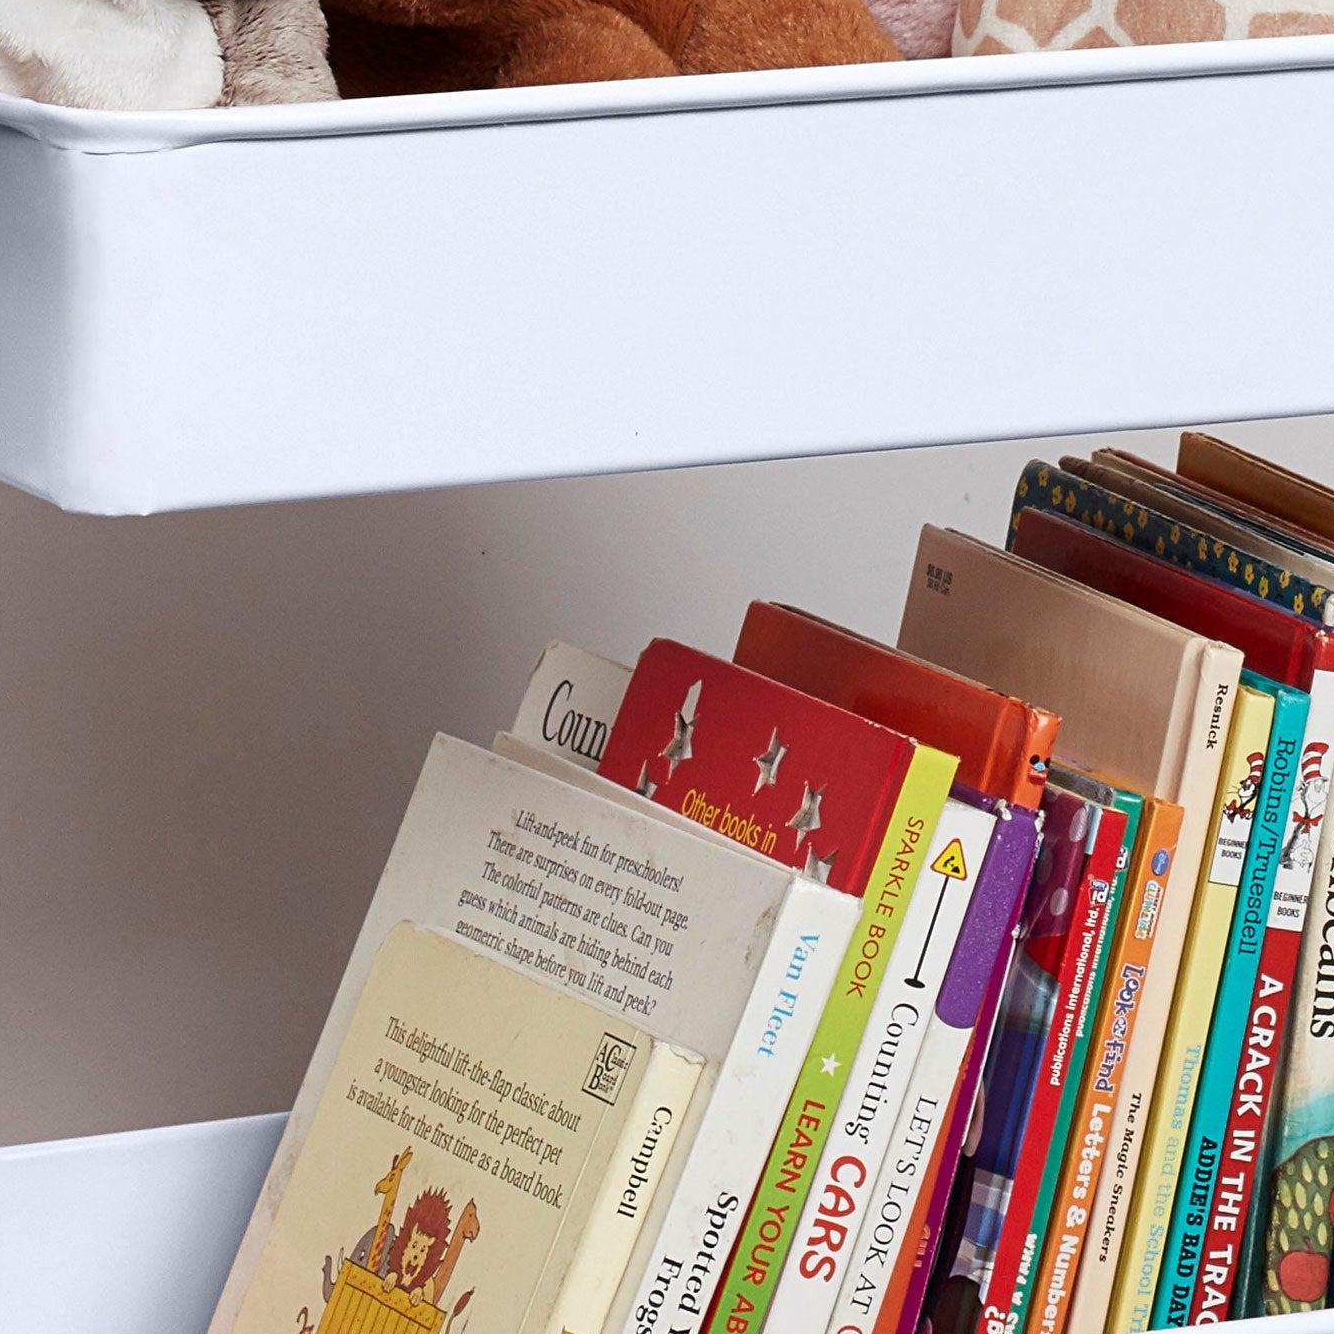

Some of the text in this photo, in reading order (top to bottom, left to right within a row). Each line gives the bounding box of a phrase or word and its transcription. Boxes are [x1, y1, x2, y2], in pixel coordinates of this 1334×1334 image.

[1206, 683, 1229, 750] Resnick
[516, 810, 684, 893] Lift-and-peek fun for preschoolers!
[681, 788, 778, 855] Other books in
[1218, 837, 1248, 849] BEGINNE
[1221, 849, 1243, 860] BOOKS
[482, 861, 674, 956] The colorful patterns are clues. Can you
[487, 830, 688, 931] There are surprises on every fold-out page.
[846, 816, 925, 999] SPARKLE BOOK
[1276, 906, 1300, 918] BOOKS
[455, 920, 657, 1016] geometric shape before you lift and peek?
[457, 889, 674, 991] guess which animals are hiding behind each
[757, 934, 820, 1058] Van Fleet
[1050, 1010, 1075, 1086] publications
[1066, 930, 1096, 1011] international,
[1085, 907, 1100, 927] ltd.
[1115, 964, 1145, 1015] Look
[1259, 973, 1284, 998] A
[385, 1016, 582, 1133] This delightful lift-the-flap classic about
[1172, 1044, 1202, 1130] Thomas
[1236, 1005, 1277, 1116] CRACK
[346, 1080, 562, 1210] is available for the first time as a board book.
[374, 1058, 564, 1166] a youngster looking for the perfect pet
[775, 1099, 826, 1194] LEARN
[799, 1003, 919, 1283] Counting CARS
[896, 1094, 938, 1177] LET'S
[1073, 1103, 1111, 1200] Letters
[1230, 1129, 1256, 1162] IN
[616, 1105, 673, 1219] Campbell
[1099, 1092, 1142, 1263] The Magic Sneakers
[1153, 1179, 1172, 1217] the
[1160, 1136, 1177, 1186] and
[1213, 1172, 1245, 1232] THE
[678, 1191, 740, 1315] Spotted
[742, 1205, 790, 1286] YOUR
[864, 1181, 909, 1267] LOOK
[1066, 1205, 1087, 1227] &
[1167, 1135, 1218, 1327] ADDIE'S BAD DAY
[850, 1272, 877, 1315] AT
[1137, 1224, 1164, 1295] School
